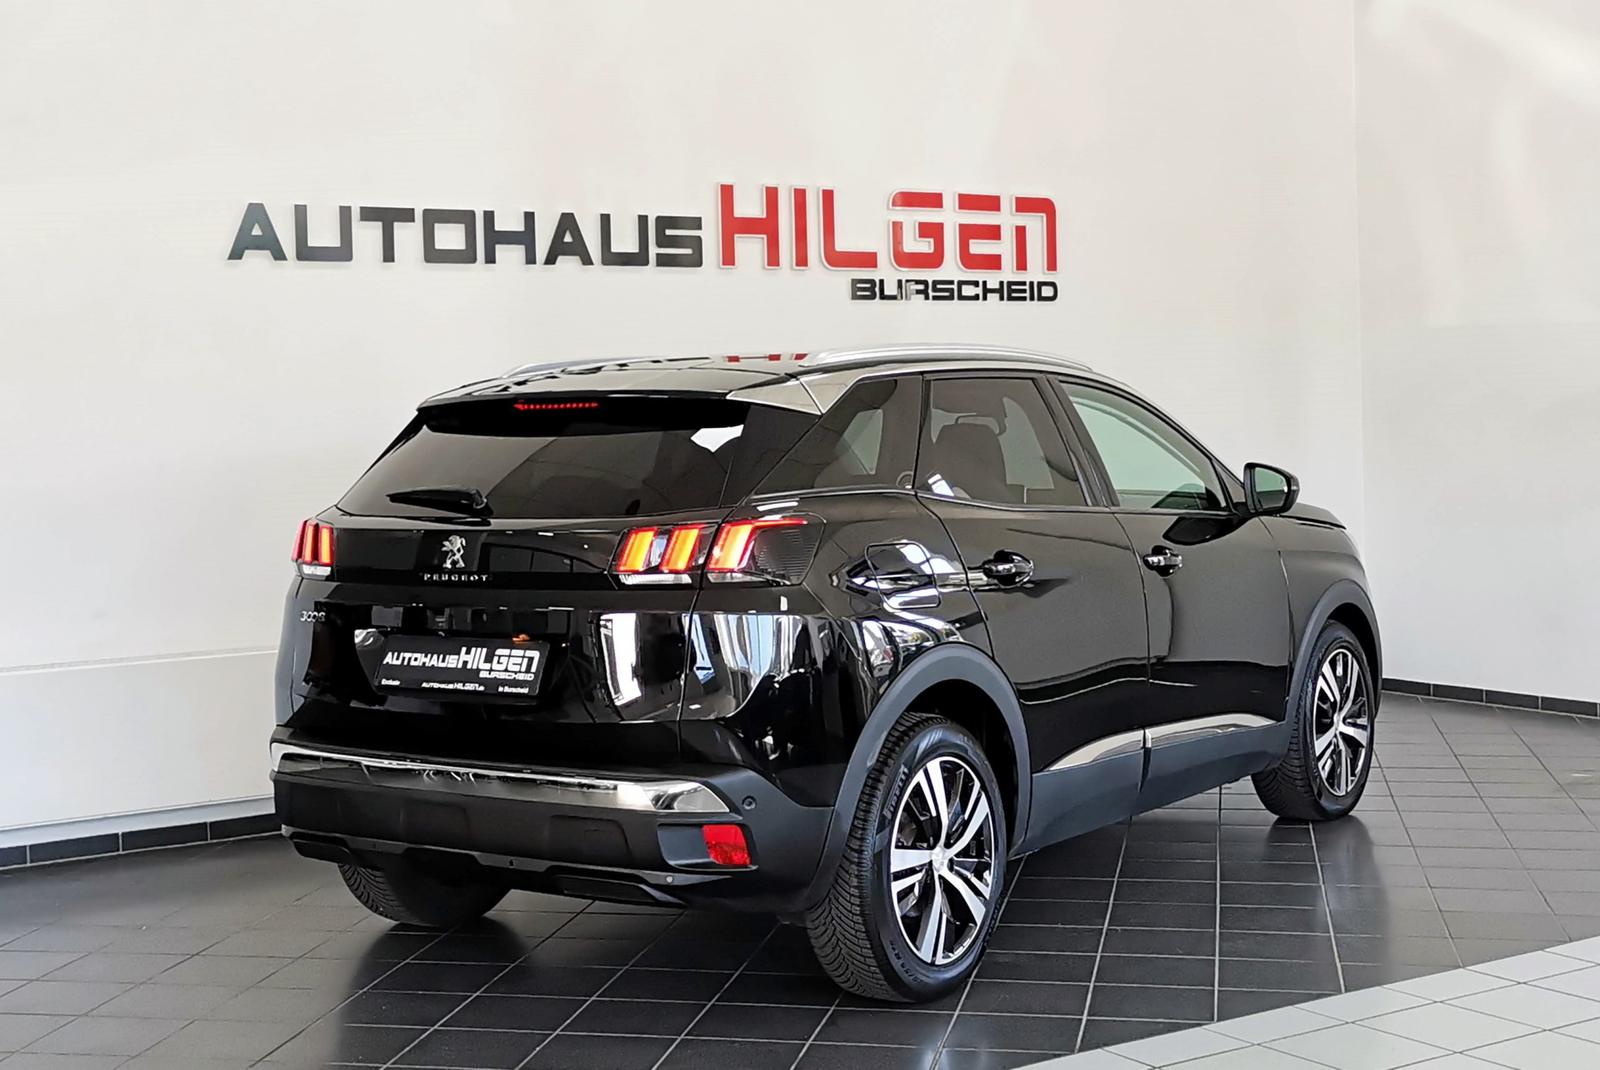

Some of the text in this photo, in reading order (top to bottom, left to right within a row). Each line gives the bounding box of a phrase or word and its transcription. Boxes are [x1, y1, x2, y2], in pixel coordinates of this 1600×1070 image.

[228, 182, 1058, 272] AUTOHAUS HILGEN
[850, 278, 1058, 302] BURSCHEID
[423, 573, 488, 582] PEUGEOT
[383, 647, 540, 672] AUTOHAUS HILGEN
